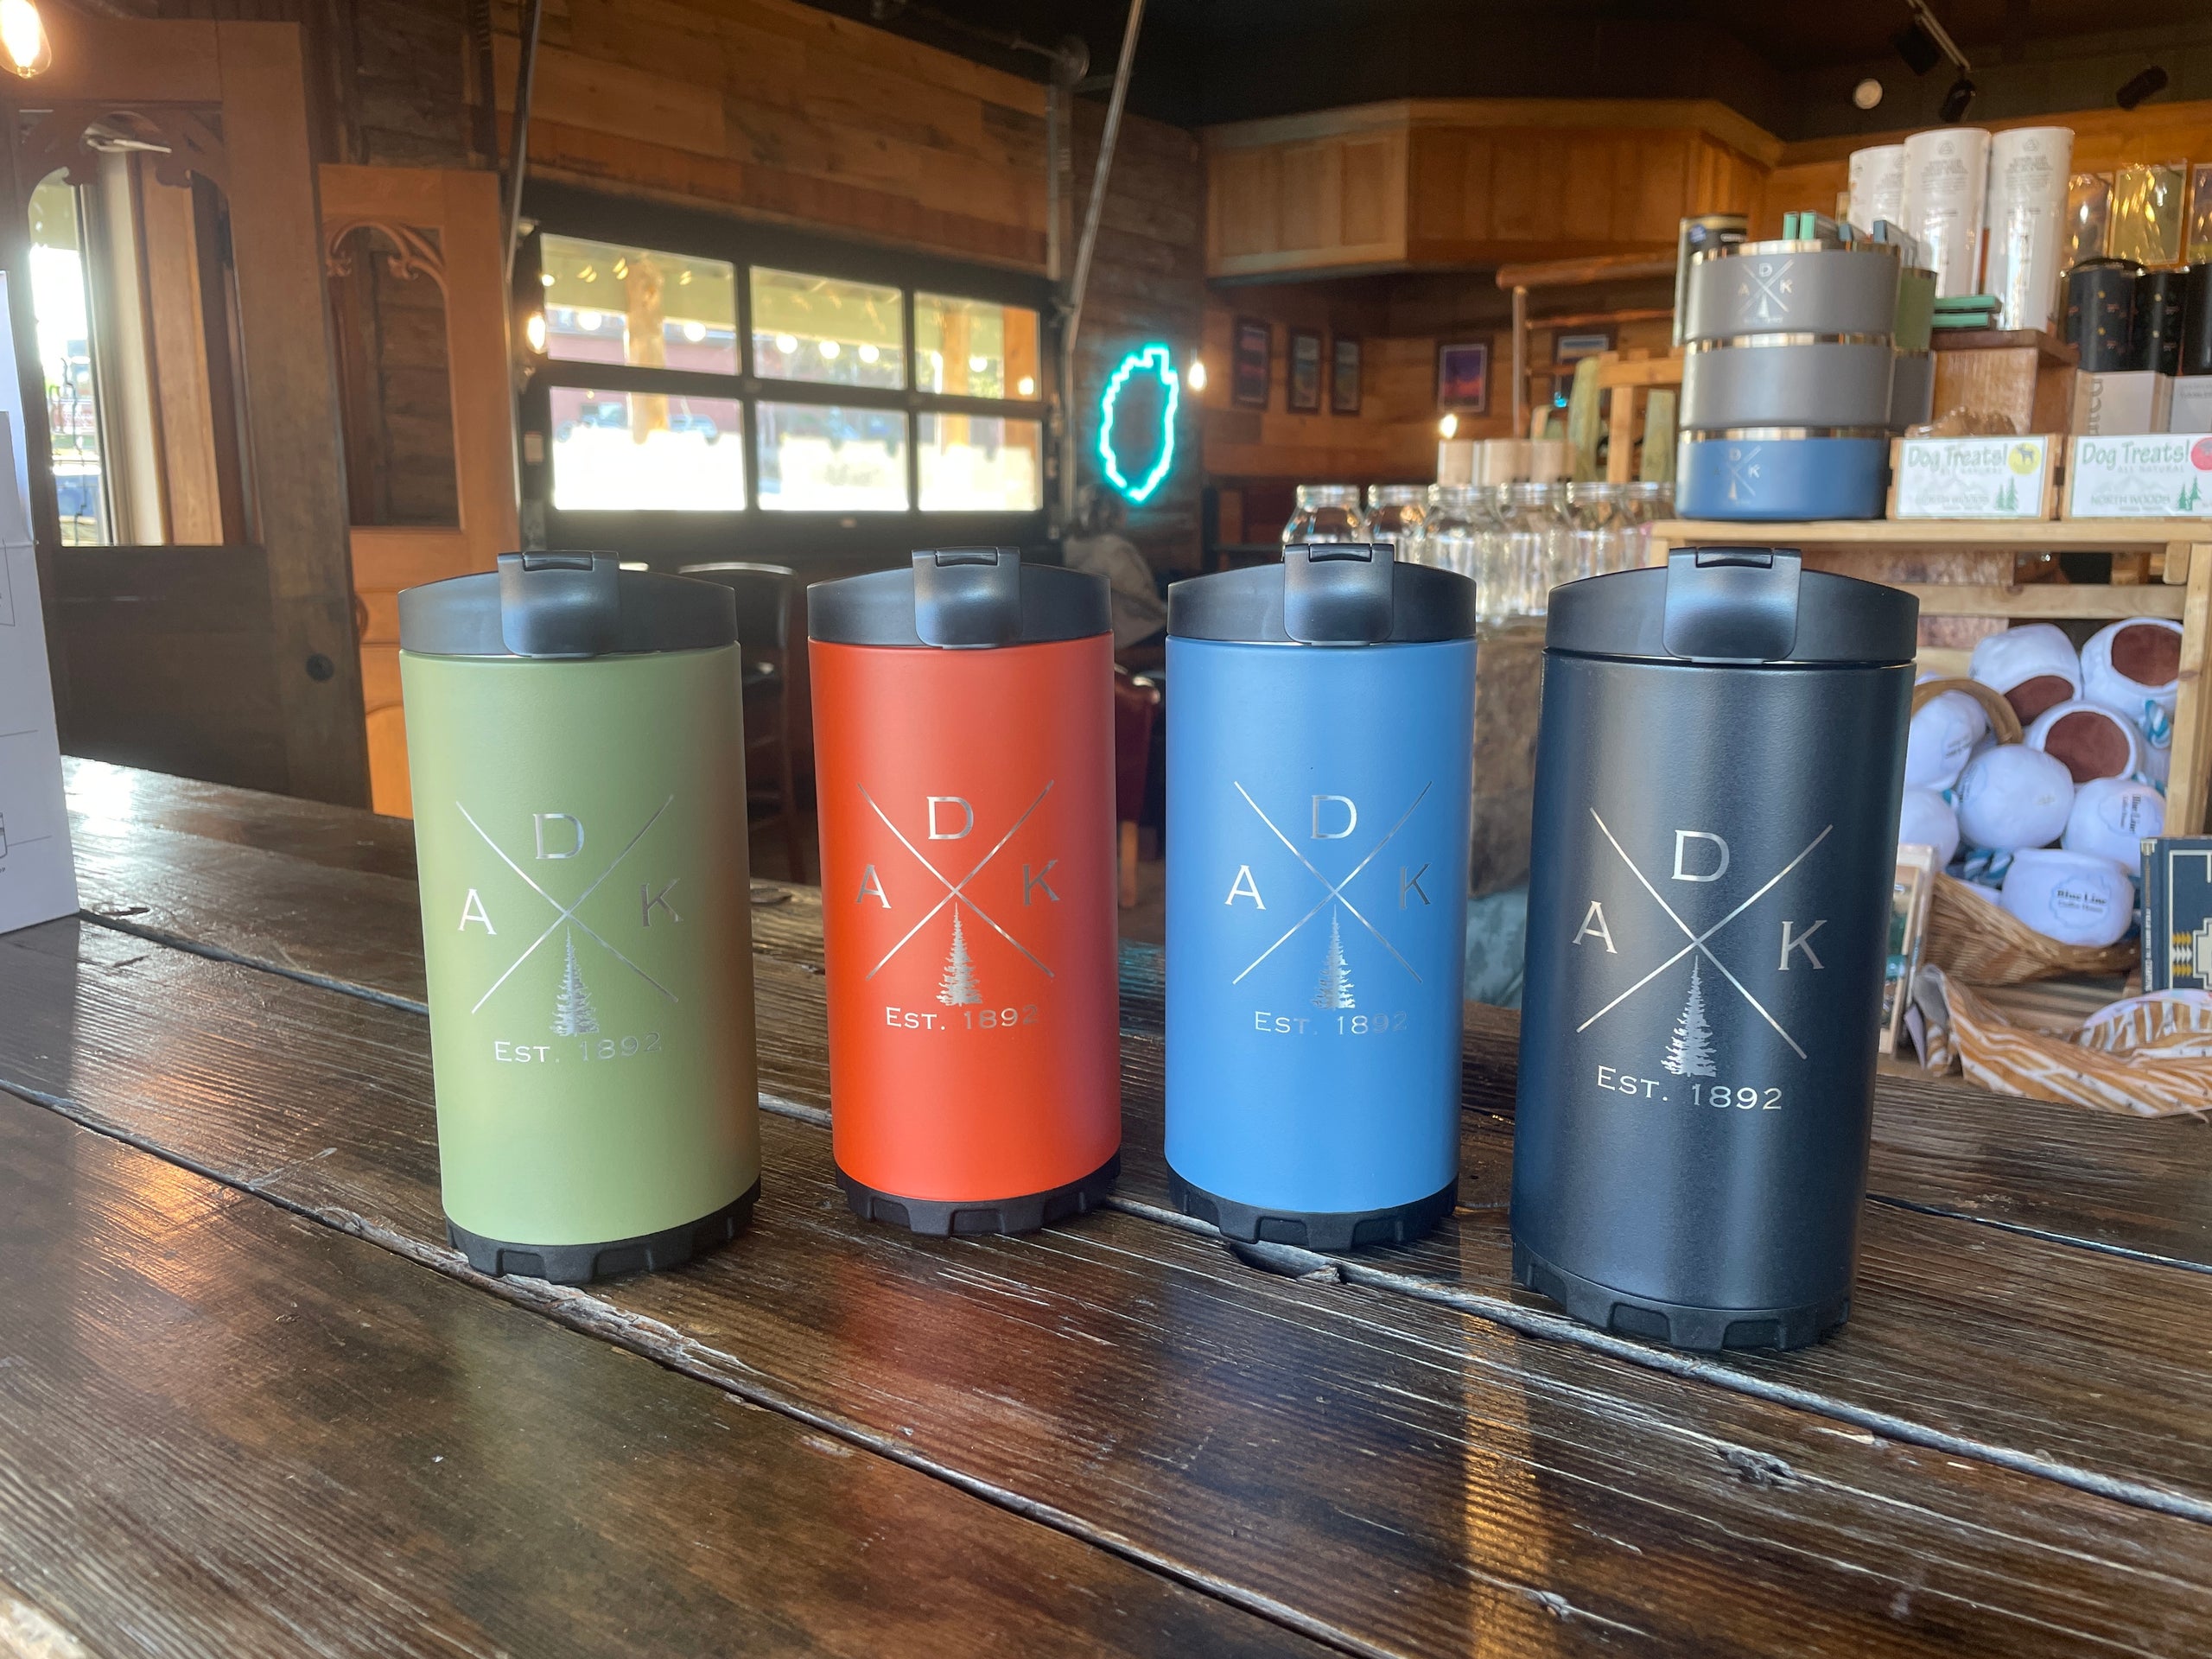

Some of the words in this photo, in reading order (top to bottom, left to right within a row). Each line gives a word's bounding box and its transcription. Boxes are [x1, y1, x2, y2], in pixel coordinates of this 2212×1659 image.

[1758, 263, 1772, 276] D
[1780, 279, 1793, 294] K
[1908, 446, 1941, 472] Dog
[1944, 442, 2008, 467] Treats!
[2082, 442, 2117, 471] Dog
[2121, 439, 2190, 464] Treats!
[1748, 464, 1760, 478] K
[927, 797, 974, 840] D
[1311, 794, 1357, 839] D
[532, 813, 585, 860] D
[1671, 830, 1730, 882] D
[856, 864, 892, 909] A
[1023, 860, 1060, 906] K
[1224, 865, 1267, 910] A
[1400, 862, 1431, 909] K
[2057, 889, 2082, 900] Blue
[2083, 892, 2107, 906] Line
[457, 888, 498, 936] A
[640, 878, 683, 928] K
[1572, 900, 1618, 954] A
[1777, 919, 1827, 971] K
[963, 1004, 1039, 1030] 1892
[1337, 1010, 1408, 1035] 1892
[579, 1031, 662, 1062] 1892
[1692, 1083, 1783, 1111] 1892
